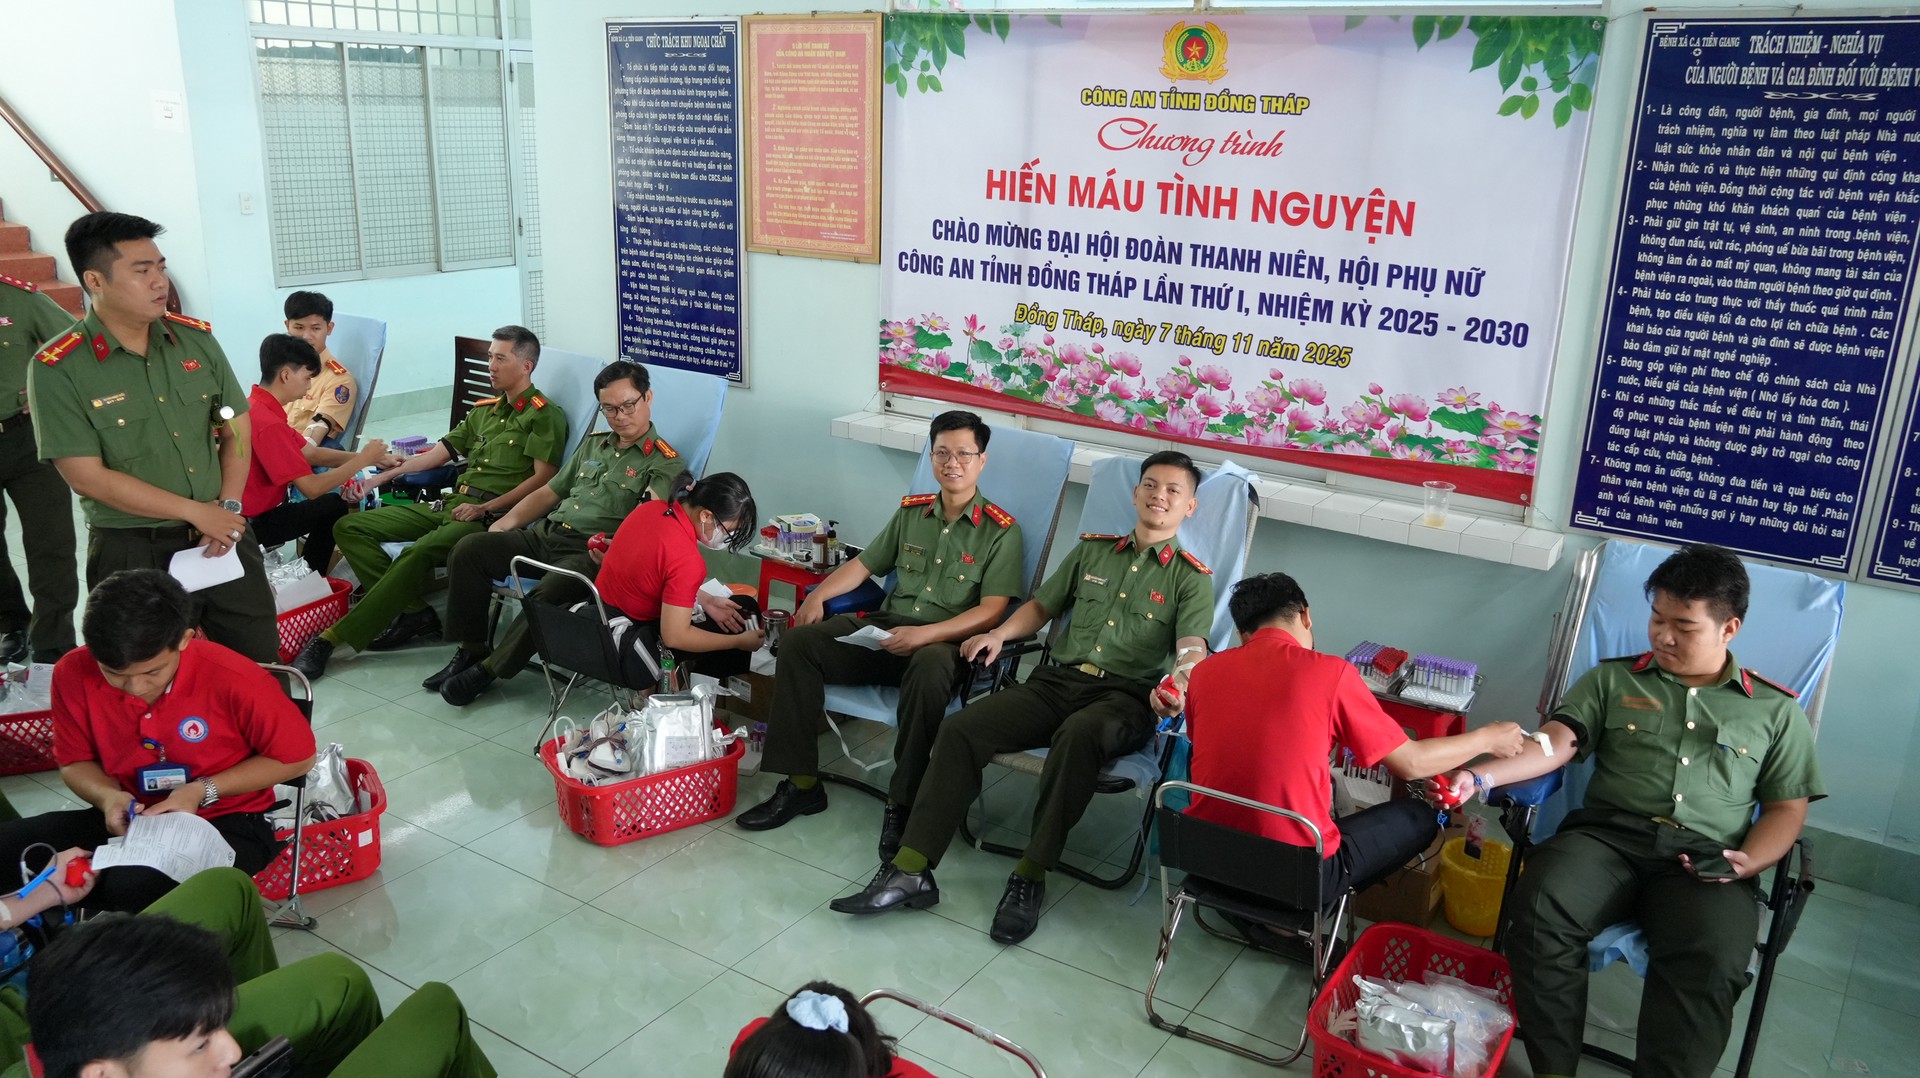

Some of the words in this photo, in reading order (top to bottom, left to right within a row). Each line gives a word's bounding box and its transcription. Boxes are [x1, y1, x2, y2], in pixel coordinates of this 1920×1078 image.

[1748, 30, 1786, 54] TRÁCH
[1785, 30, 1823, 58] NHIỆM
[1828, 30, 1864, 54] NGHĨA
[1867, 34, 1884, 58] VỤ
[1685, 59, 1705, 84] CỦA
[1706, 61, 1739, 84] NGƯỜI
[1738, 61, 1770, 89] BỆNH
[1771, 61, 1785, 85] VÀ
[1786, 66, 1805, 85] GIA
[1806, 61, 1836, 86] ĐÌNH
[1835, 58, 1858, 86] ĐỐI
[1859, 61, 1879, 86] VỚI
[1878, 62, 1913, 91] BỆNH
[1080, 85, 1127, 107] CÔNG
[1129, 89, 1156, 109] AN
[1159, 86, 1201, 111] TỈNH
[1203, 88, 1256, 113] ĐỒNG
[1259, 92, 1310, 116] THÁP
[1660, 103, 1672, 115] Là
[1678, 104, 1701, 119] công
[1708, 105, 1728, 118] dân,
[1735, 105, 1763, 120] người
[1768, 106, 1795, 120] bệnh,
[1803, 107, 1819, 122] gia
[1826, 108, 1850, 121] đình,
[1858, 109, 1879, 123] mọi
[1885, 109, 1916, 124] người
[1097, 117, 1215, 167] Chương
[1219, 129, 1285, 157] trình
[1657, 122, 1680, 134] trách
[1685, 124, 1715, 137] nhiệm,
[1721, 125, 1747, 139] nghĩa
[1753, 128, 1764, 140] vụ
[1770, 126, 1787, 138] làm
[1793, 127, 1815, 139] theo
[1820, 128, 1839, 142] luật
[1844, 128, 1870, 143] pháp
[1876, 129, 1897, 141] Nhà
[1654, 142, 1672, 155] luật
[1676, 142, 1693, 154] sức
[1698, 142, 1721, 155] khỏe
[1726, 144, 1750, 156] nhân
[1756, 145, 1775, 157] dân
[1781, 146, 1792, 158] và
[1798, 147, 1815, 161] nội
[1820, 148, 1837, 162] qui
[1842, 148, 1868, 163] bệnh
[1875, 149, 1897, 164] viện
[1651, 160, 1675, 174] Nhận
[1679, 162, 1699, 173] thức
[1703, 163, 1714, 174] rõ
[1719, 163, 1730, 175] và
[1735, 164, 1756, 178] thực
[1760, 165, 1781, 179] hiện
[1786, 166, 1817, 181] những
[1822, 168, 1838, 182] qui
[1843, 168, 1865, 183] định
[1870, 169, 1896, 185] công
[986, 158, 1056, 206] HIẾN
[1068, 168, 1144, 212] MÁU
[1157, 172, 1238, 220] TÌNH
[1251, 187, 1416, 245] NGUYỆN
[1642, 215, 1663, 227] Phải
[1665, 217, 1681, 230] giữ
[1684, 218, 1699, 231] gìn
[1703, 219, 1719, 232] trật
[1723, 221, 1734, 234] tự,
[1739, 221, 1750, 235] vệ
[1754, 223, 1777, 236] sinh,
[1782, 226, 1794, 235] an
[1798, 225, 1820, 237] ninh
[1825, 227, 1851, 242] trong
[1855, 228, 1881, 242] bệnh
[1886, 230, 1910, 244] viện,
[932, 216, 979, 243] CHÀO
[985, 224, 1041, 250] MỪNG
[1047, 229, 1079, 258] ĐẠI
[1086, 233, 1119, 262] HỘI
[1125, 237, 1183, 265] ĐOÀN
[1189, 243, 1261, 273] THANH
[1268, 251, 1329, 284] NIÊN,
[1338, 258, 1379, 290] HỘI
[1386, 263, 1437, 298] PHỤ
[1444, 269, 1485, 297] NỮ
[898, 248, 943, 276] CÔNG
[948, 257, 974, 279] AN
[980, 254, 1022, 285] TỈNH
[1027, 262, 1080, 292] ĐỒNG
[1086, 270, 1137, 298] THÁP
[1143, 275, 1183, 305] LẦN
[1190, 282, 1233, 310] THỨ
[1237, 289, 1249, 316] I,
[1257, 291, 1333, 326] NHIỆM
[1340, 298, 1372, 328] KỲ
[1377, 306, 1439, 336] 2025
[1463, 316, 1529, 348] 2030
[1015, 302, 1059, 330] Đồng
[1062, 308, 1108, 338] Tháp,
[1111, 317, 1157, 345] ngày
[1158, 321, 1173, 343] 7
[1173, 324, 1227, 356] tháng
[1232, 331, 1253, 354] 11
[1255, 335, 1300, 361] năm
[1301, 341, 1353, 368] 2025
[1620, 356, 1643, 371] Đóng
[1647, 359, 1664, 373] góp
[1669, 362, 1687, 375] viện
[1691, 365, 1707, 377] phí
[1711, 367, 1730, 379] theo
[1735, 369, 1753, 381] chế
[1756, 372, 1769, 385] độ
[1774, 374, 1800, 386] chính
[1805, 377, 1828, 389] sách
[1833, 379, 1851, 392] của
[1856, 382, 1876, 395] Nhà
[1595, 506, 1610, 516] trái
[1615, 508, 1631, 520] của
[1636, 513, 1658, 524] nhân
[1664, 518, 1682, 529] viên
[1904, 537, 1917, 549] về
